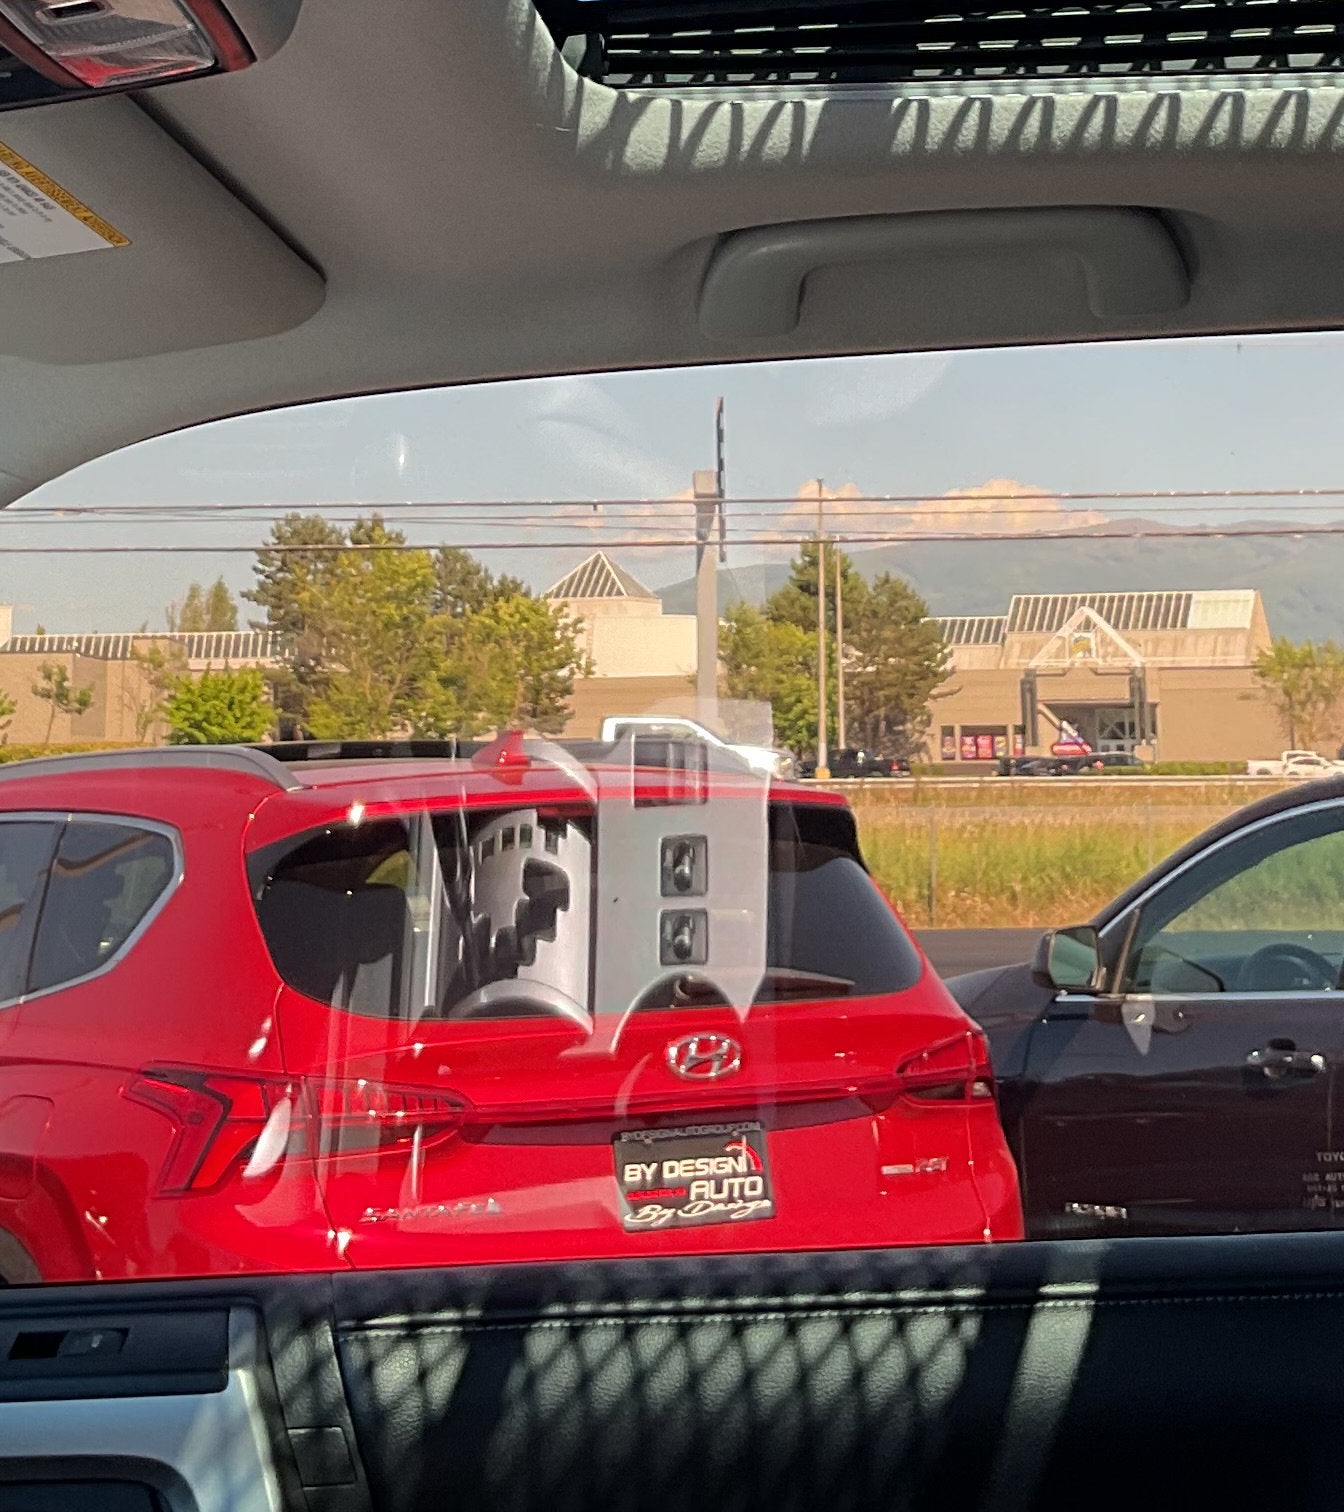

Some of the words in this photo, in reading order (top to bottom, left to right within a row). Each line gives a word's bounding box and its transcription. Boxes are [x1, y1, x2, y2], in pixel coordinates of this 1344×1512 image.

[624, 1162, 657, 1182] BY
[662, 1156, 748, 1179] DESIGN
[689, 1176, 763, 1200] AUTO
[625, 1204, 676, 1226] By
[677, 1199, 772, 1219] Design
